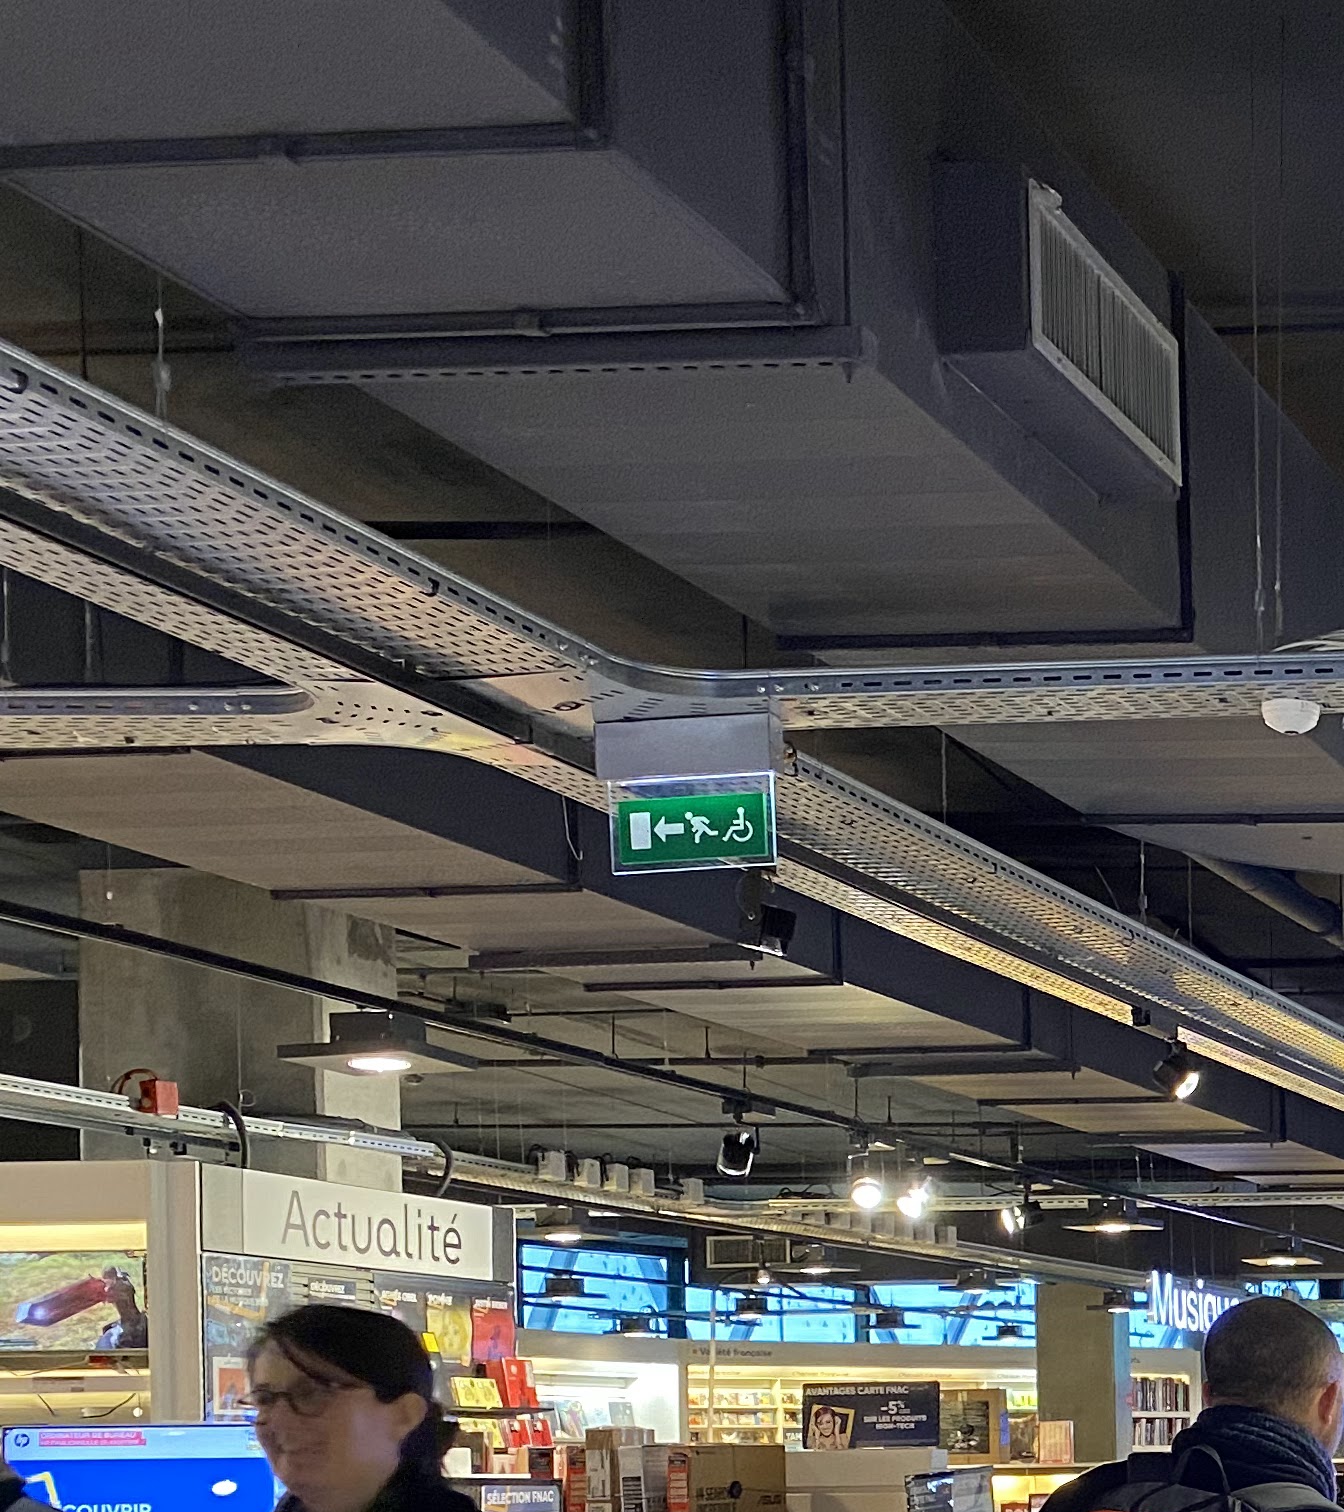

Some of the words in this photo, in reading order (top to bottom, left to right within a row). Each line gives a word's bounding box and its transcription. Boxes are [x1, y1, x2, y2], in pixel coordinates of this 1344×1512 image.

[281, 1190, 463, 1265] Actualité
[211, 1263, 285, 1289] DÉCOUVREZ
[805, 1386, 855, 1396] AVANTAGES
[857, 1386, 885, 1395] CARTE
[885, 1386, 909, 1395] FNAC
[891, 1414, 928, 1423] PRODUITS
[486, 1488, 530, 1505] SÉLECTION
[531, 1489, 554, 1503] FNAC
